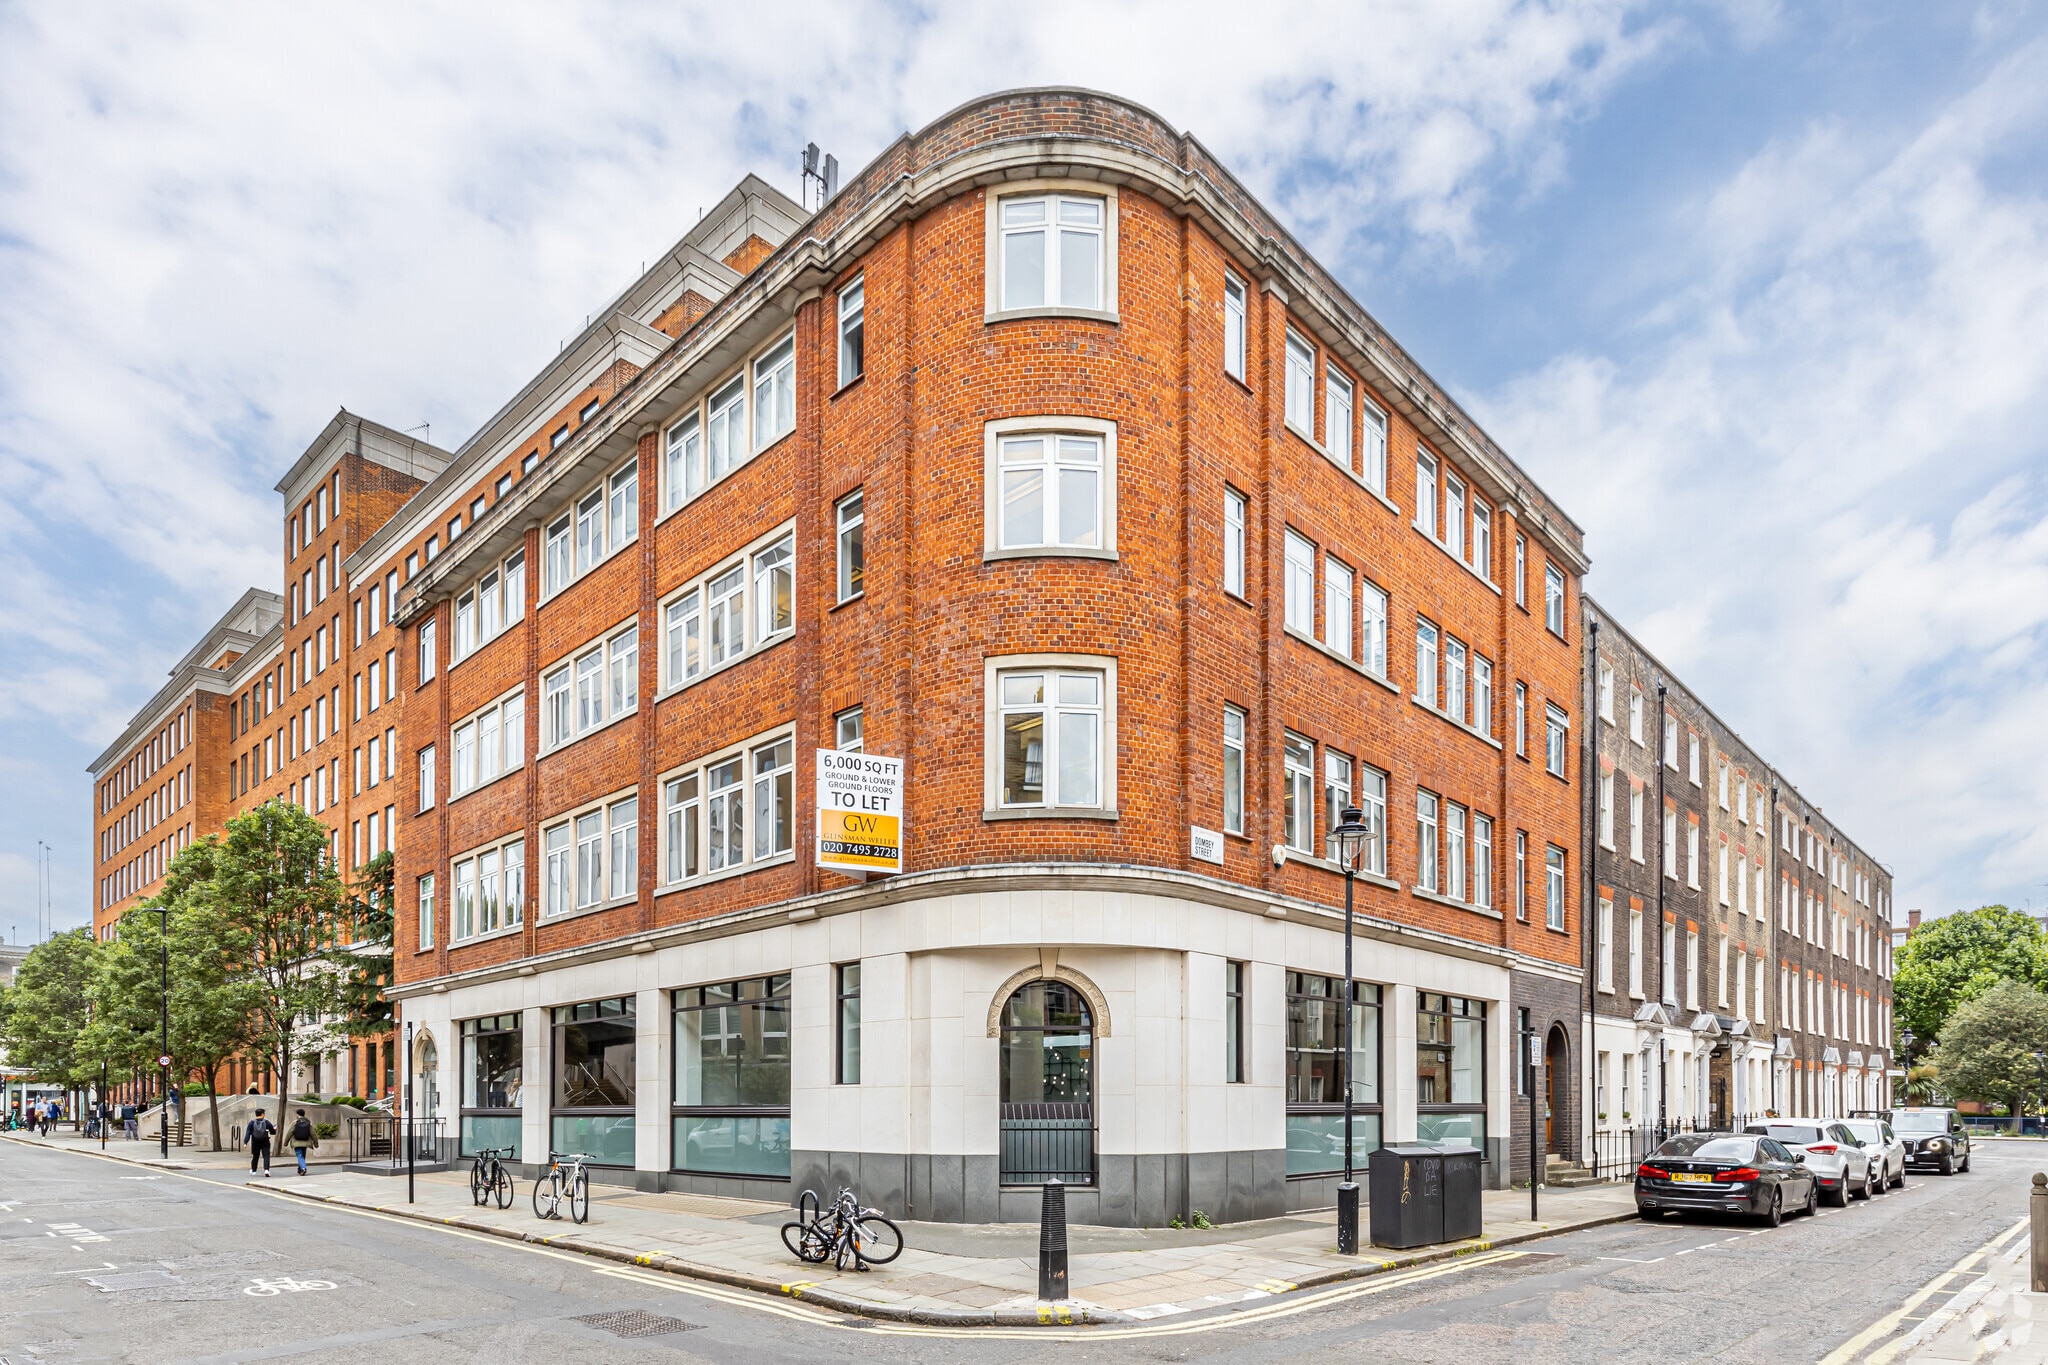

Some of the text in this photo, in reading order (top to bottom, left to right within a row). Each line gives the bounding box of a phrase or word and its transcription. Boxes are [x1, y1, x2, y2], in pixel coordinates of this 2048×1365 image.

[824, 755, 898, 775] 6,000 SQ FT
[825, 772, 860, 782] GROUND
[870, 777, 896, 786] LOWER
[828, 781, 893, 794] GROUND FLOORS
[831, 791, 890, 811] TO LET
[843, 815, 878, 833] GW
[823, 833, 897, 846] GLINSMAN WELLER
[1195, 836, 1215, 849] DOMBEY
[823, 842, 897, 858] 020 7495 2728
[1195, 846, 1212, 858] STREET
